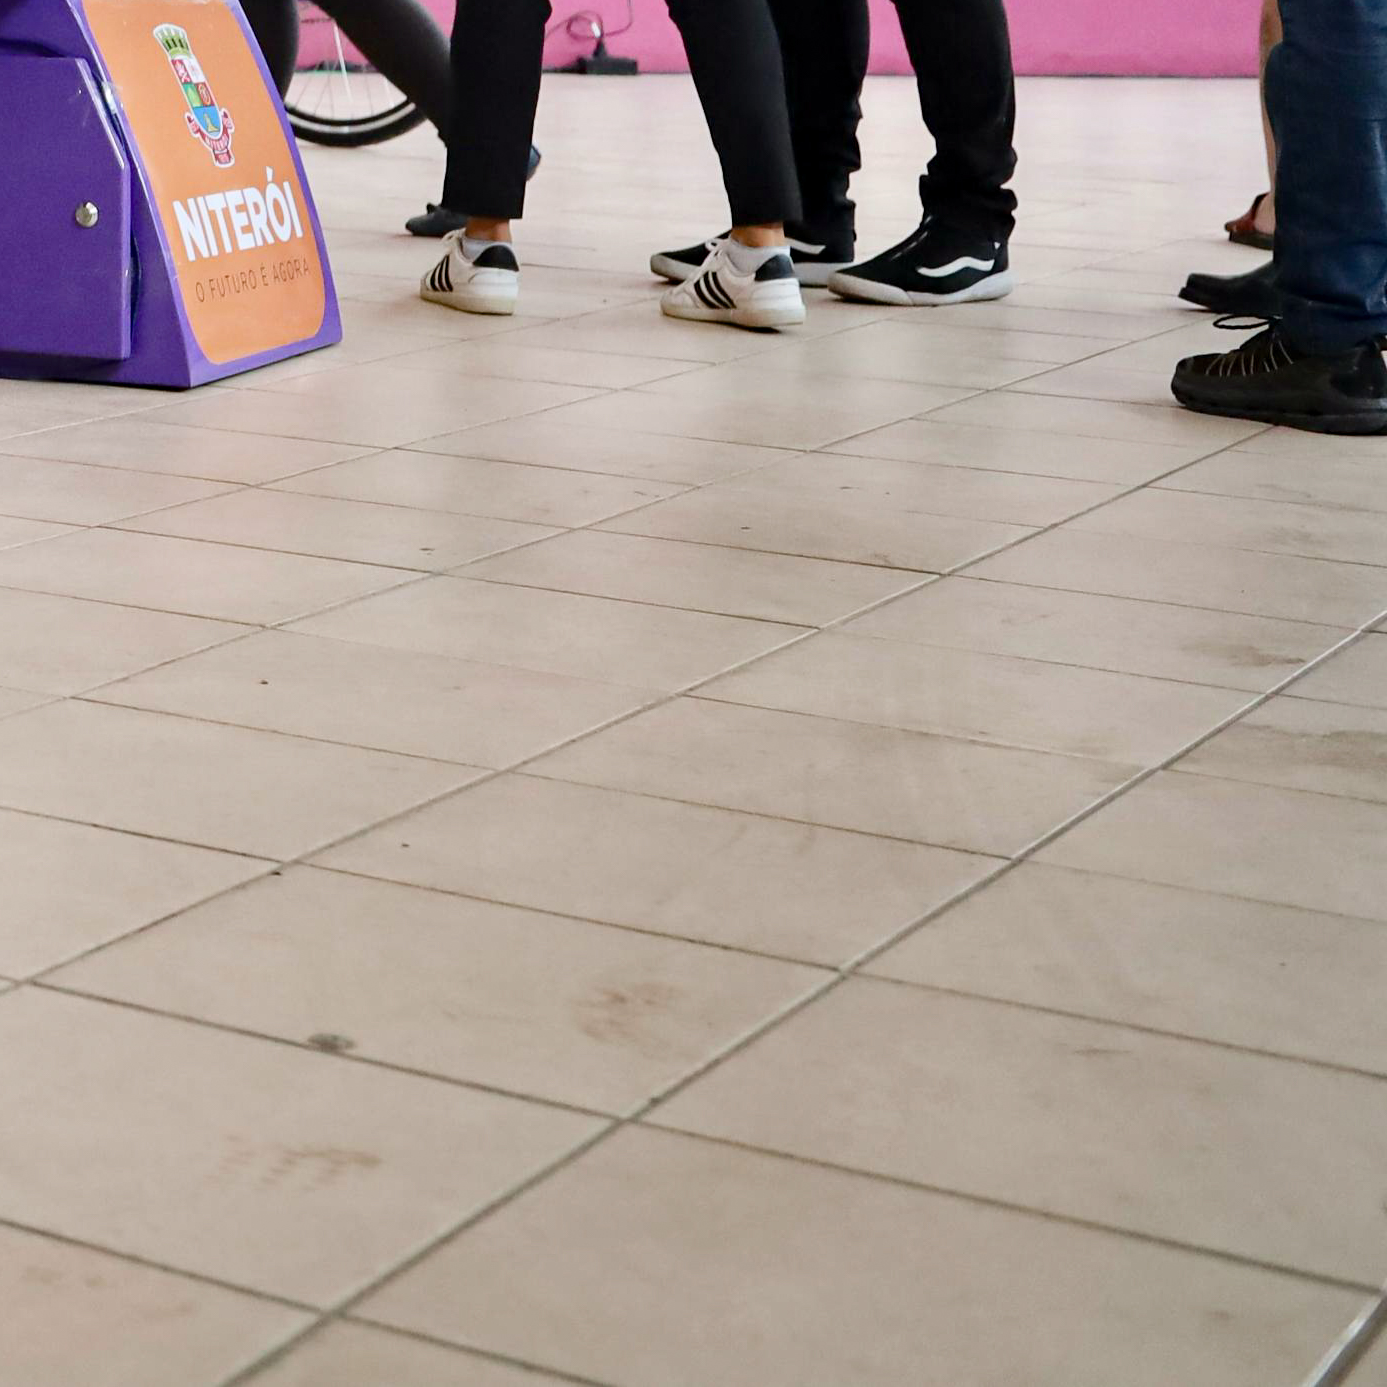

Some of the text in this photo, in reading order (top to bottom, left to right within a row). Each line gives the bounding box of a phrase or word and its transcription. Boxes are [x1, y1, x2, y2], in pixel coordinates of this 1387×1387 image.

[172, 166, 303, 262] NITERÓI
[195, 257, 310, 303] O FUTURO É AGORA
